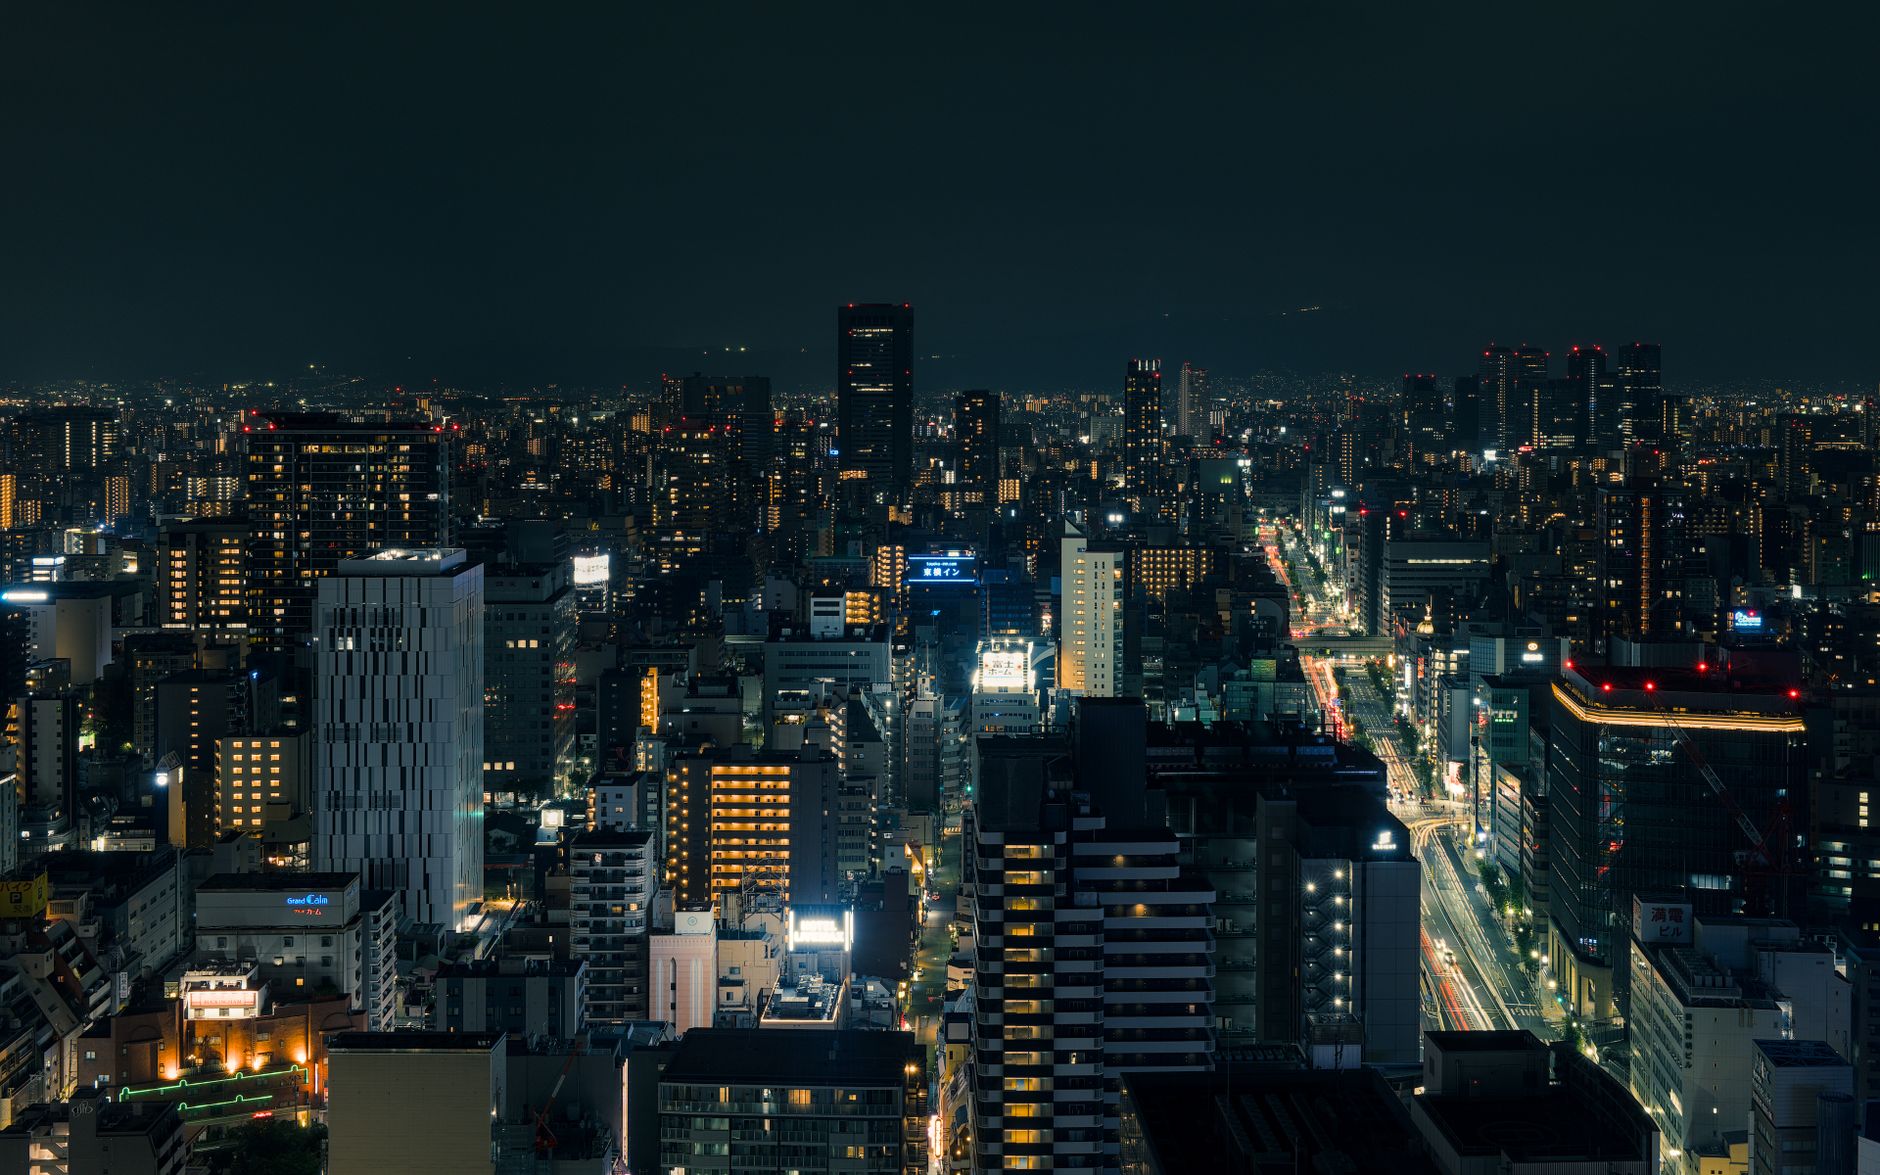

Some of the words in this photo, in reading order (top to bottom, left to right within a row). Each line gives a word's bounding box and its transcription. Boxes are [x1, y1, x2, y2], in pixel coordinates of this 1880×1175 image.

[923, 568, 960, 576] 東横イン
[287, 897, 306, 905] Grand
[306, 894, 328, 905] Calm
[1659, 926, 1682, 937] ビル
